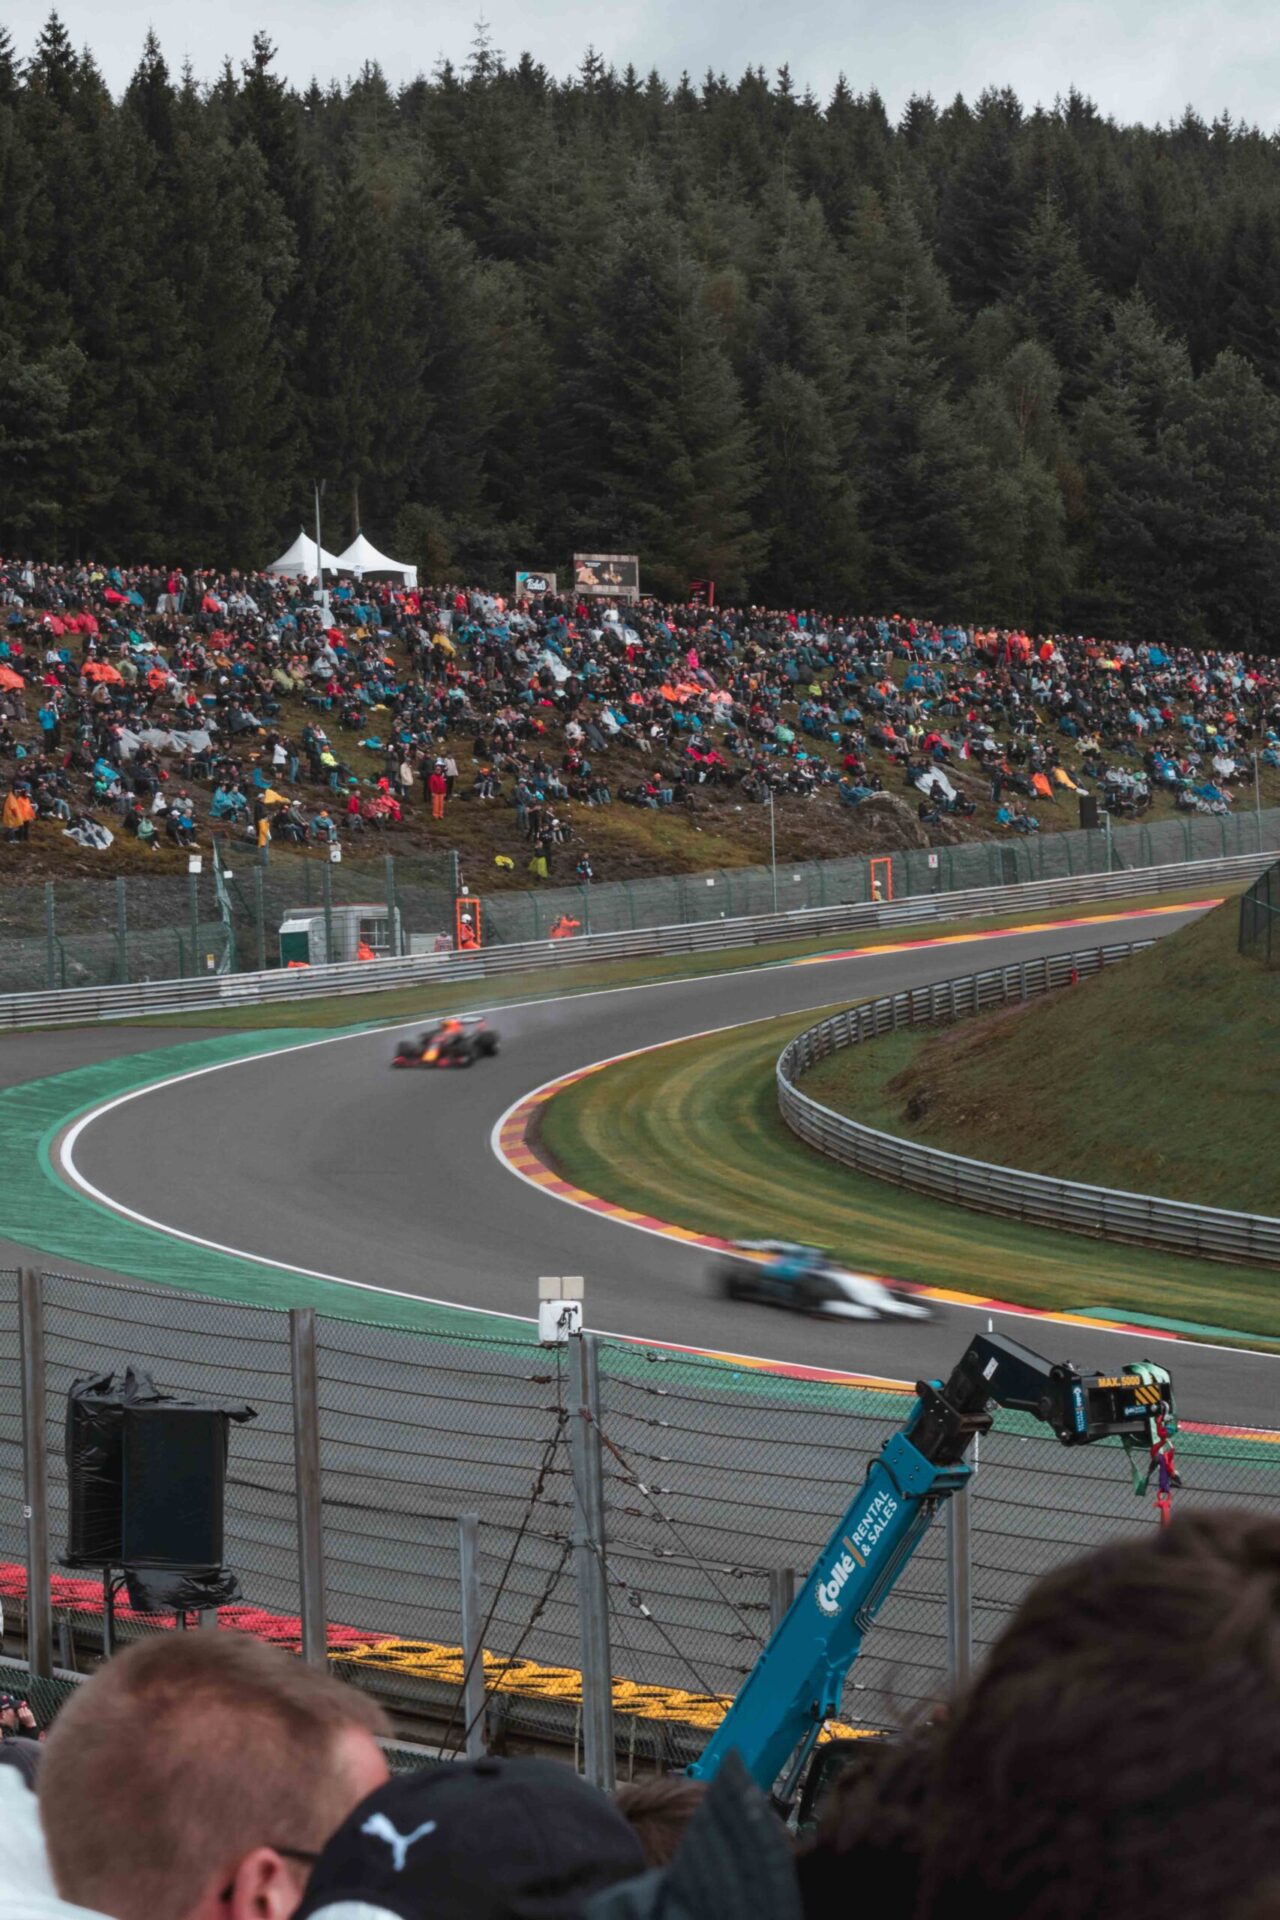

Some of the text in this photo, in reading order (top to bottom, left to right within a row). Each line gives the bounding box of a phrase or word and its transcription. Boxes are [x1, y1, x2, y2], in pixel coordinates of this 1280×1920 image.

[851, 1490, 890, 1546] RENTAL
[860, 1498, 898, 1557] & SALES
[818, 1551, 856, 1612] Collé
